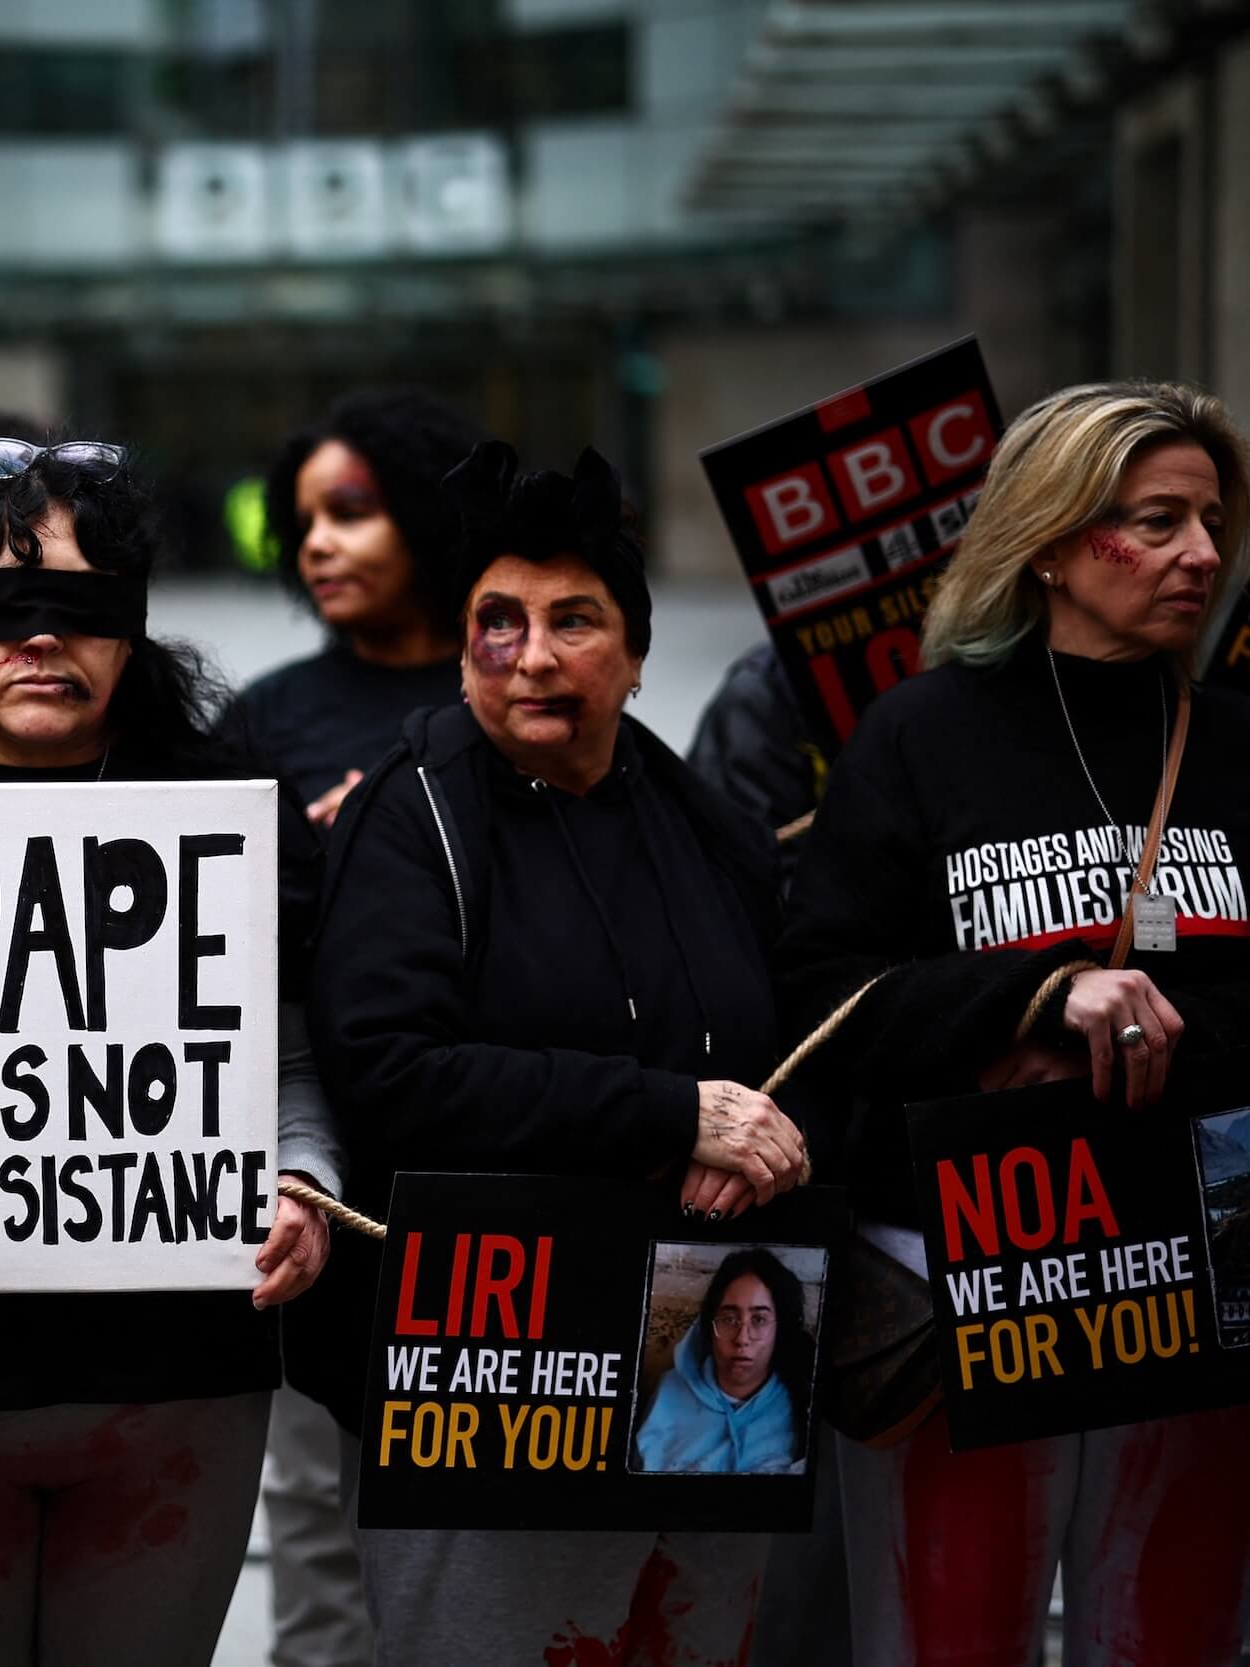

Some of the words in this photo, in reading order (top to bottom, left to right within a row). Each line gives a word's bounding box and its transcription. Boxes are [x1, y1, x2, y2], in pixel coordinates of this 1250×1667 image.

[761, 405, 985, 543] BBC
[797, 605, 874, 655] YOUR
[946, 833, 1071, 895] HOSTAGES
[1075, 825, 1122, 868] AND
[1126, 825, 1233, 864] MSING
[950, 868, 1114, 951] FAMILIES
[1116, 865, 1247, 922] FRUM
[67, 1041, 231, 1139] NOT
[937, 1138, 1120, 1262] NOA
[395, 1232, 552, 1339] LIRI
[946, 1266, 1007, 1316] WE
[1019, 1253, 1090, 1307] ARE
[1100, 1236, 1194, 1293] HERE
[387, 1346, 441, 1391] WE
[449, 1348, 521, 1394] ARE
[531, 1351, 621, 1397] HERE
[956, 1314, 1064, 1390] FOR
[1075, 1289, 1199, 1369] YOU!
[379, 1401, 479, 1468] FOR
[499, 1404, 613, 1471] YOU!
